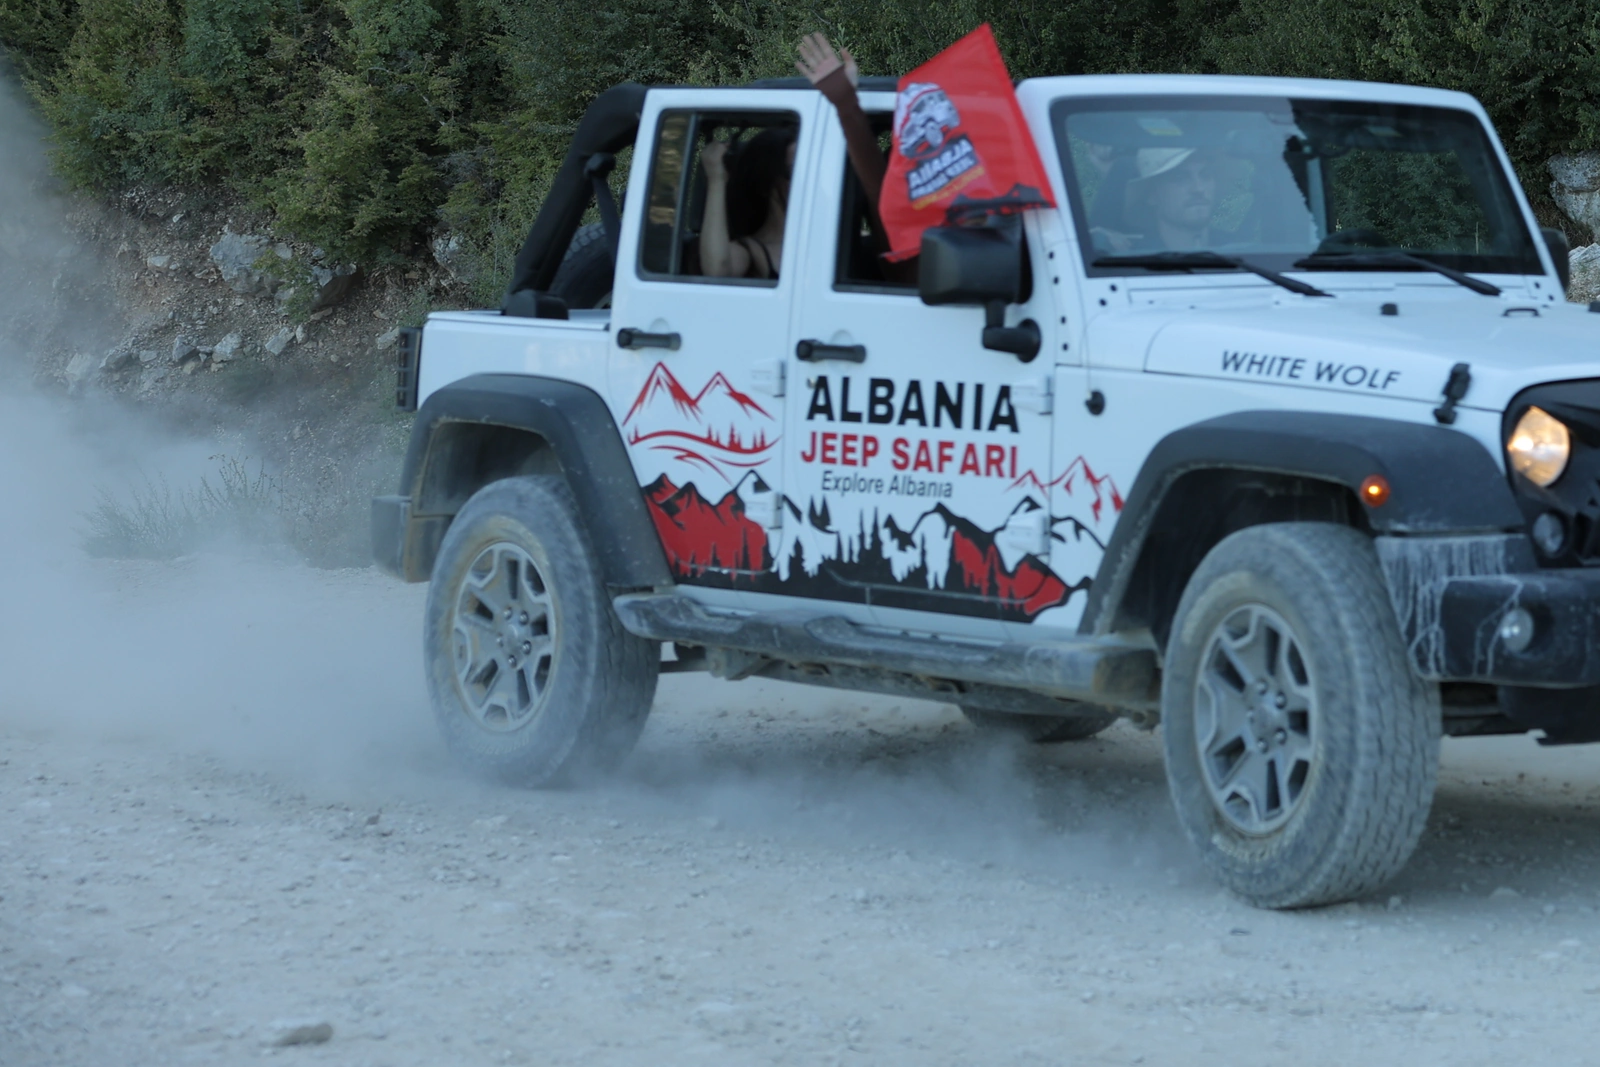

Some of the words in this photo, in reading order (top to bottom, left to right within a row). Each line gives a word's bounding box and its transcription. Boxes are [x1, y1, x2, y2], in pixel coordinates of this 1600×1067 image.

[1221, 350, 1307, 380] WHITE
[1315, 361, 1401, 390] WOLF
[806, 375, 1020, 433] ALBANIA
[801, 431, 880, 467] JEEP
[891, 437, 1017, 479] SAFARI
[821, 470, 884, 498] Explore
[887, 474, 953, 498] Albania
